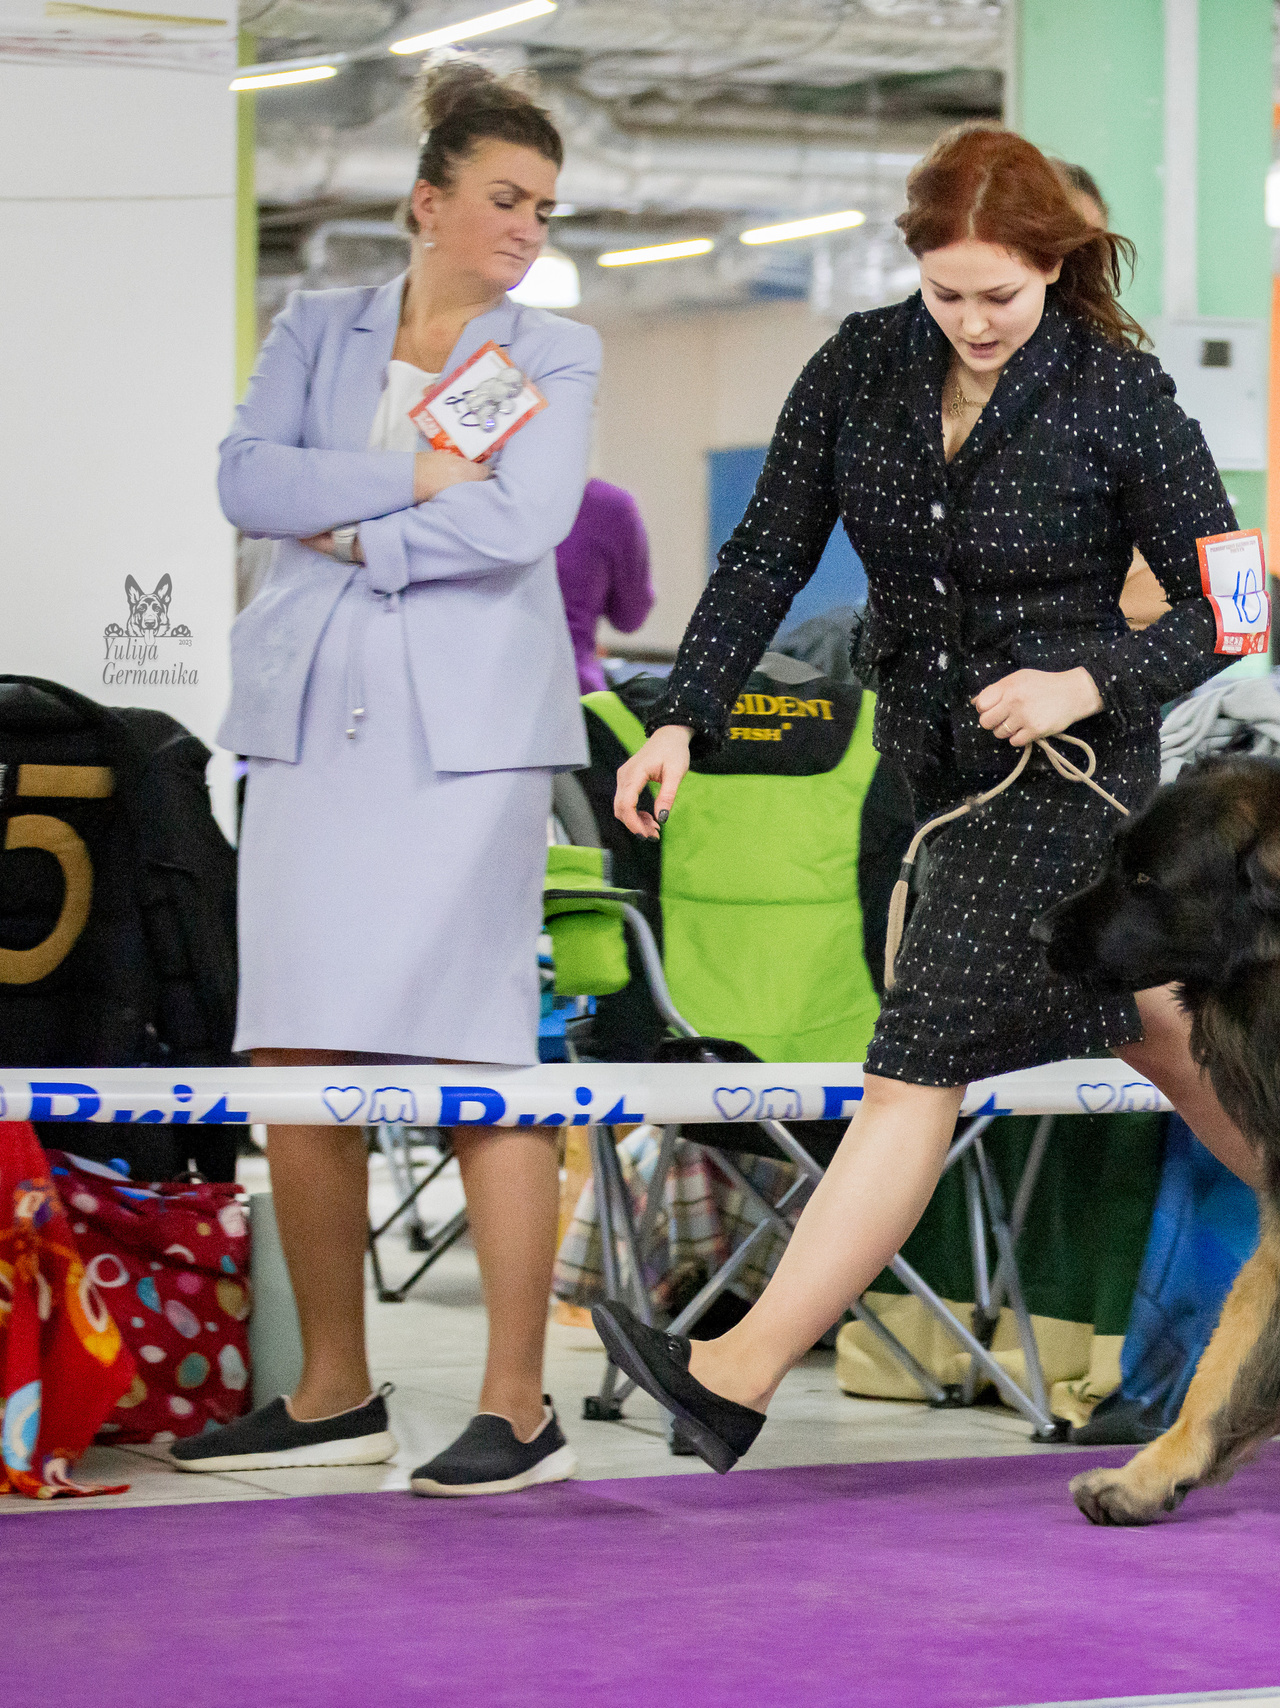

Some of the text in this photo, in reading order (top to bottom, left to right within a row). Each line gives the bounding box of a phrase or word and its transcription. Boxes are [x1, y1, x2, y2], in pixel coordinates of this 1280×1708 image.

[1232, 568, 1262, 624] 10
[29, 1082, 250, 1124] Bit
[439, 1086, 645, 1127] Bit
